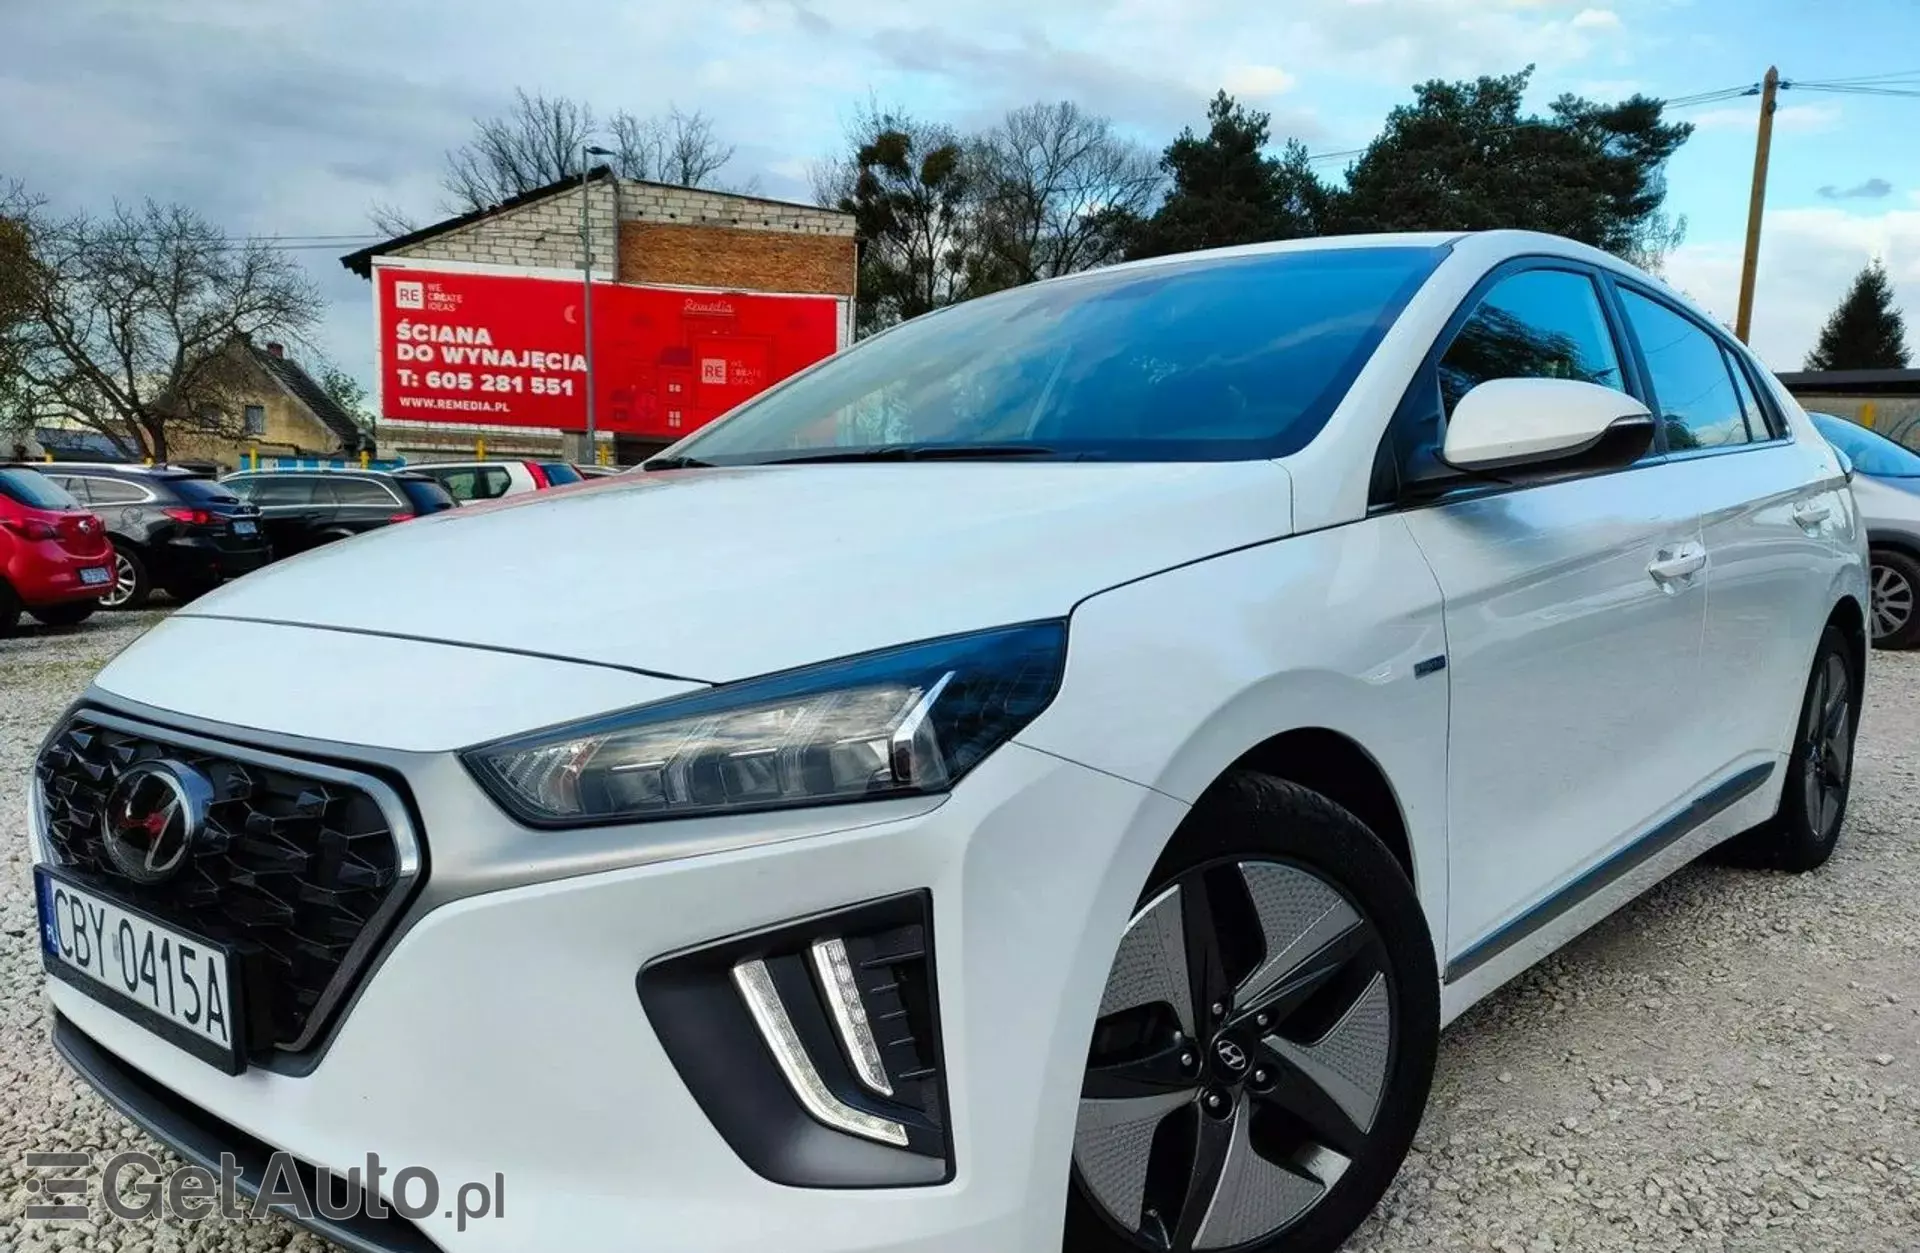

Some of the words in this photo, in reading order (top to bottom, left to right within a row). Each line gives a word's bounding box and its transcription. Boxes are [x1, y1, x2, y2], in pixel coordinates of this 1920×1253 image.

[400, 288, 419, 301] RE
[428, 292, 463, 303] CREATE
[396, 318, 493, 345] ŚCIANA
[397, 344, 434, 361] DO
[441, 346, 588, 372] WYNAJĘCIA
[704, 364, 723, 378] RE
[397, 369, 419, 387] T:
[426, 371, 473, 390] 605
[480, 374, 523, 393] 281
[530, 377, 574, 396] 551
[399, 396, 511, 413] WWW.REMEDIA.PL
[54, 888, 105, 977] CBY
[119, 918, 228, 1041] 0415A
